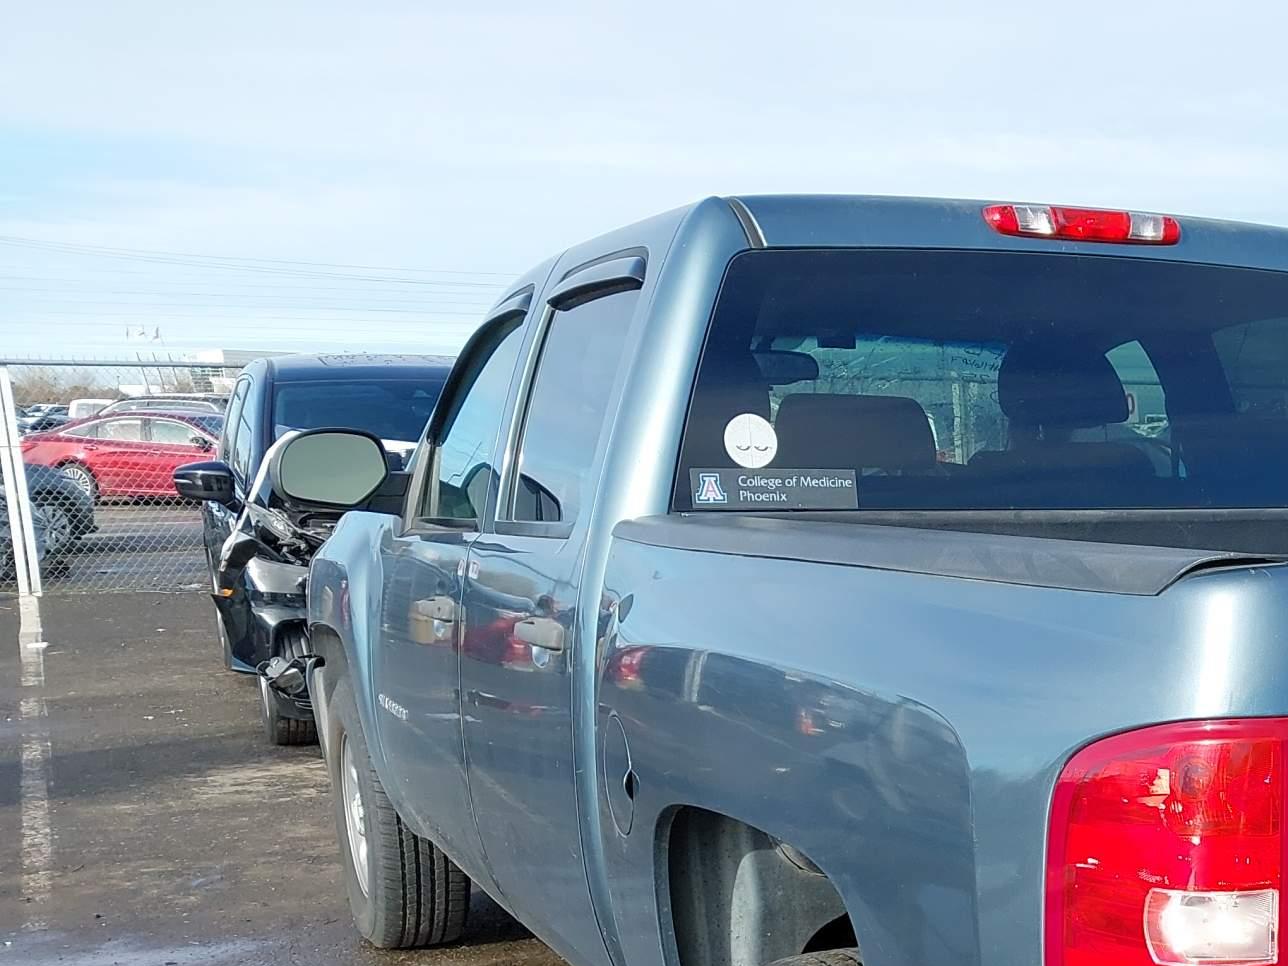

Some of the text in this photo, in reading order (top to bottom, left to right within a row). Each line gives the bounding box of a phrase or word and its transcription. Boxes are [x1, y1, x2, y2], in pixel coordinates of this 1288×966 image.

[738, 475, 852, 490] College of Medicine
[740, 490, 787, 502] Phoenix
